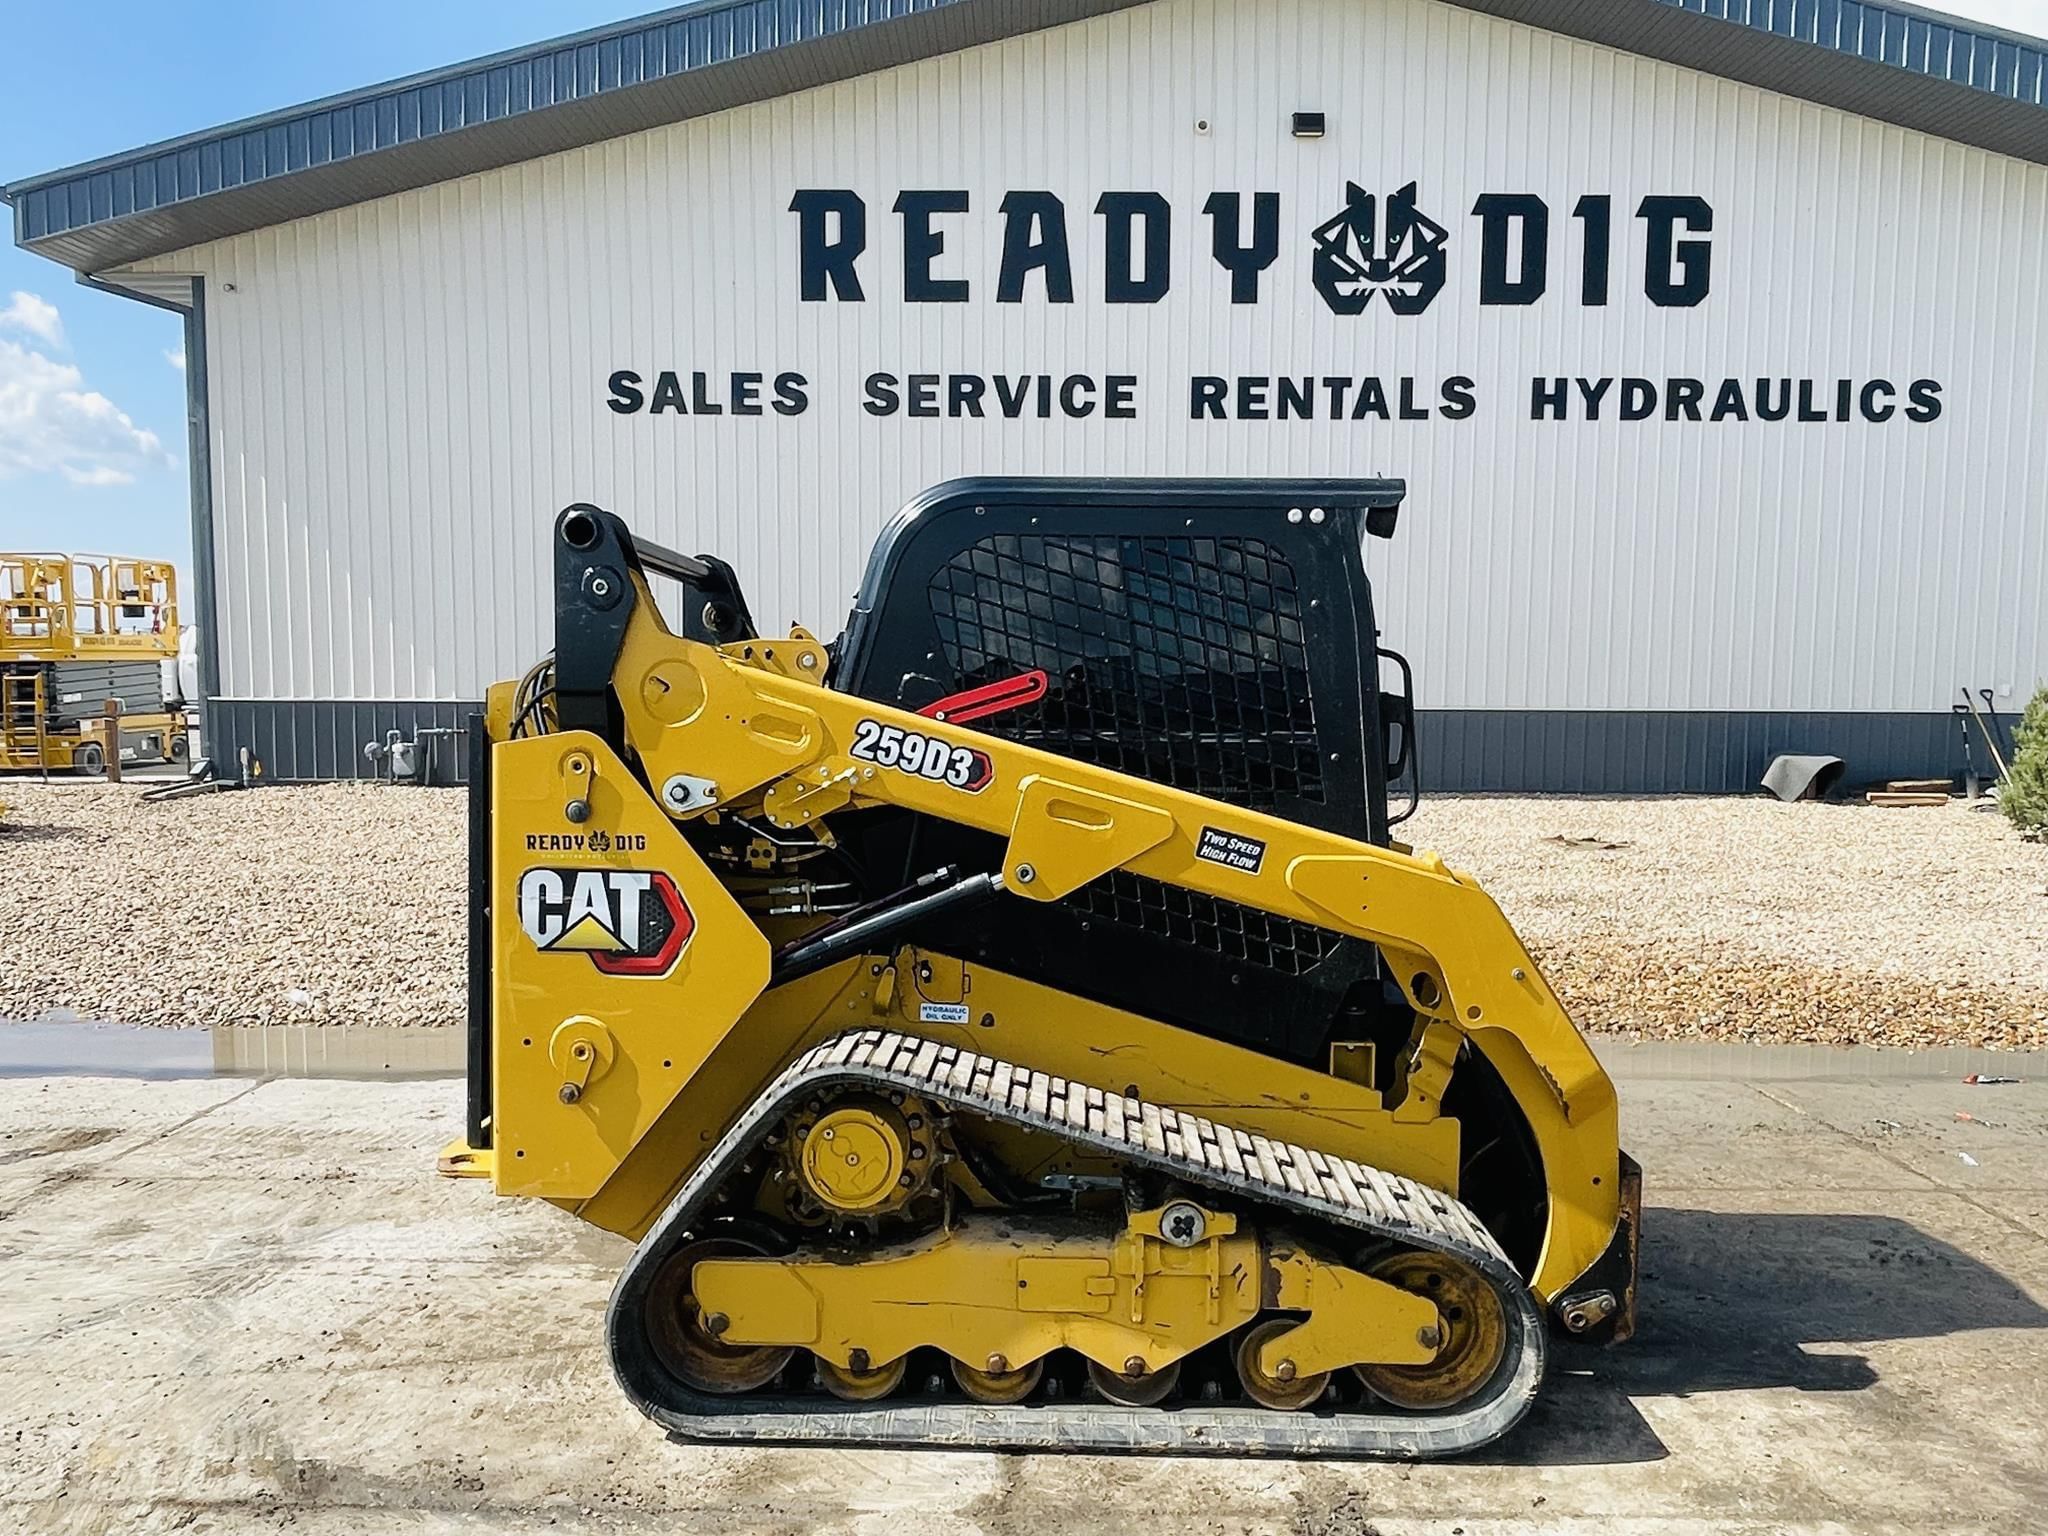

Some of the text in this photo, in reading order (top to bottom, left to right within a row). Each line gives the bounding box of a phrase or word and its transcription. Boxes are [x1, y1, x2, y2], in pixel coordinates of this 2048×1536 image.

[787, 189, 1714, 308] READY DIG
[606, 370, 1943, 423] SALES SERVICE RENTALS HYDRAULICS
[852, 720, 973, 786] 259D3
[526, 835, 646, 851] READY DIG
[521, 869, 651, 952] CAT
[922, 1005, 967, 1014] HYDRAULIC
